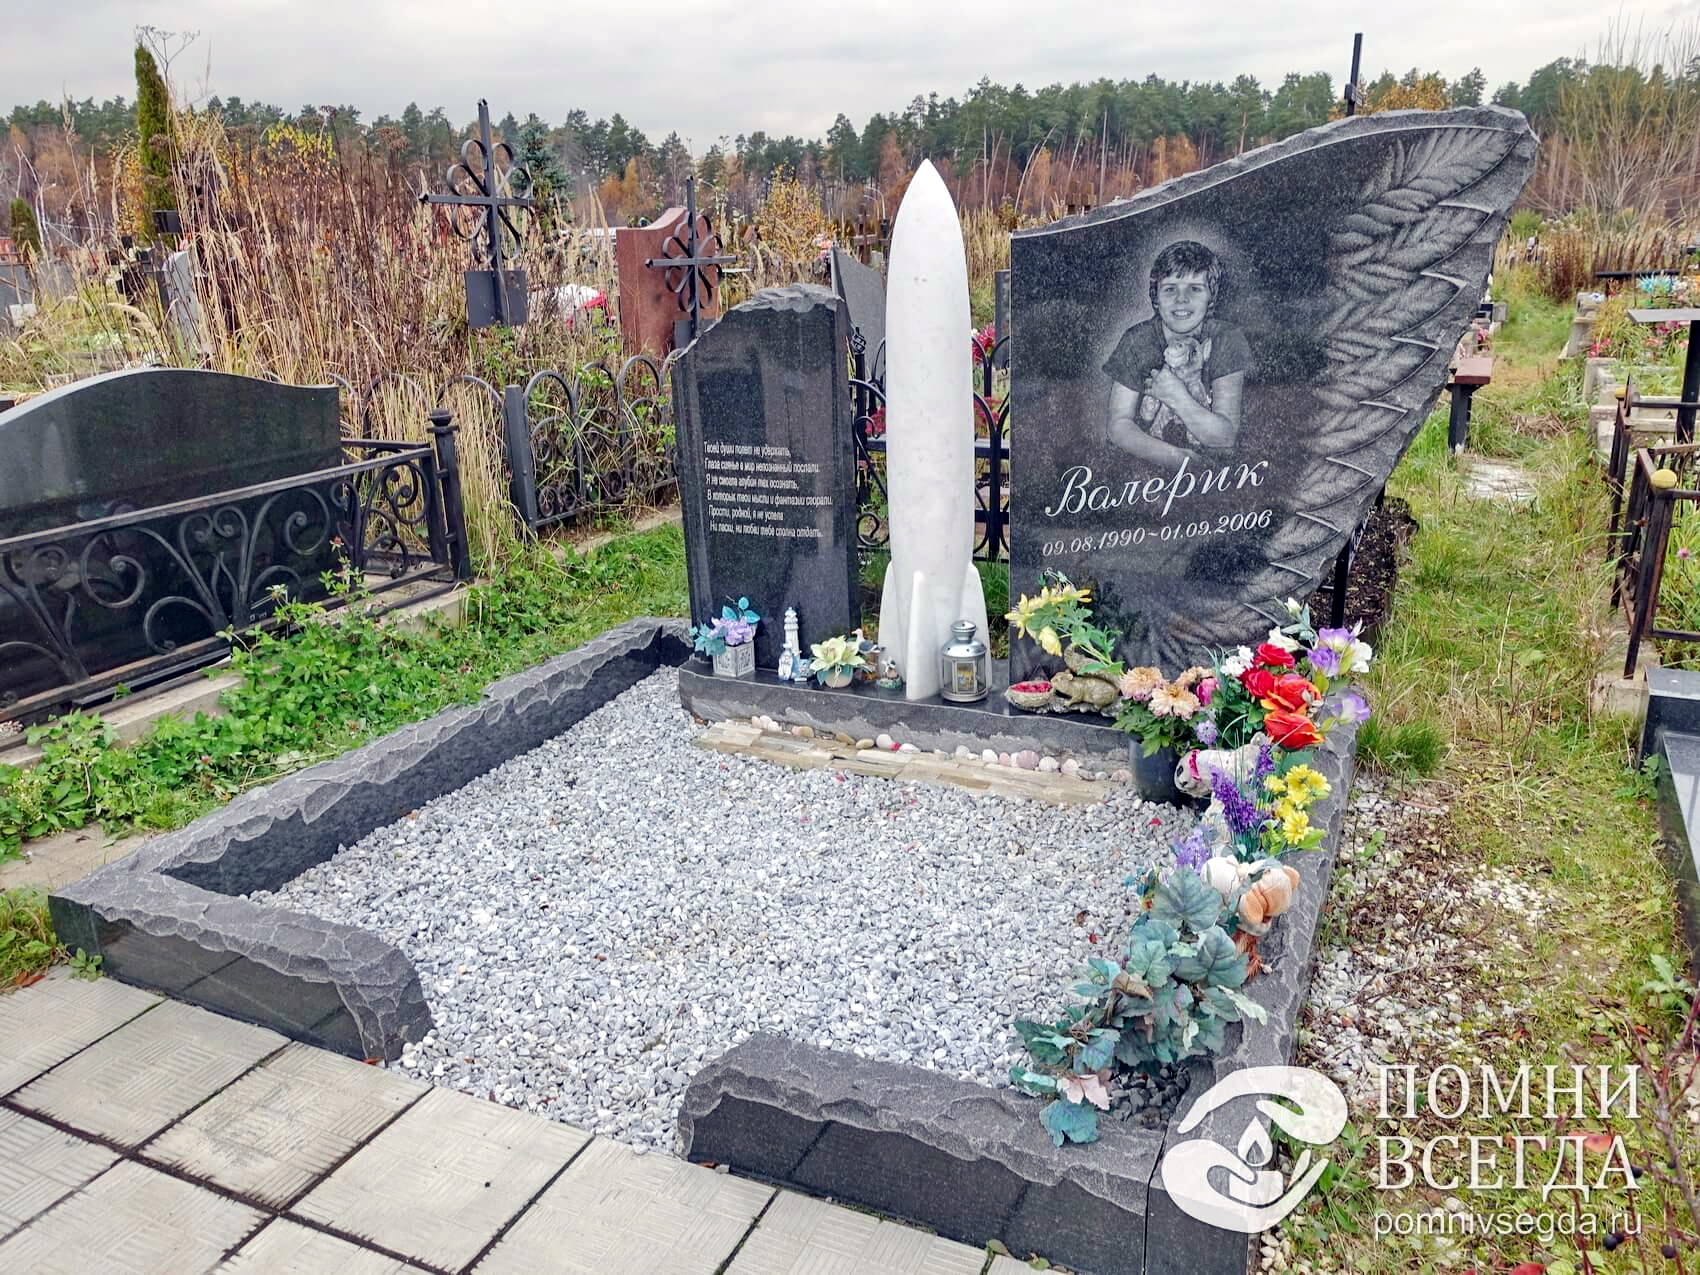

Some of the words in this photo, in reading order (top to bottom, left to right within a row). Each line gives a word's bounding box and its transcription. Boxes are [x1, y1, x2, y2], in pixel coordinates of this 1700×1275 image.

[704, 441, 719, 454] Твоей
[720, 442, 734, 455] души
[754, 446, 760, 455] не
[705, 458, 720, 470] Глаза
[745, 463, 754, 473] мир
[706, 474, 710, 484] Я
[712, 475, 718, 485] не
[1045, 457, 1268, 518] Валерик
[708, 489, 711, 500] В
[752, 495, 769, 503] мысли
[770, 496, 774, 504] и
[757, 511, 764, 519] не
[710, 521, 717, 531] Ни
